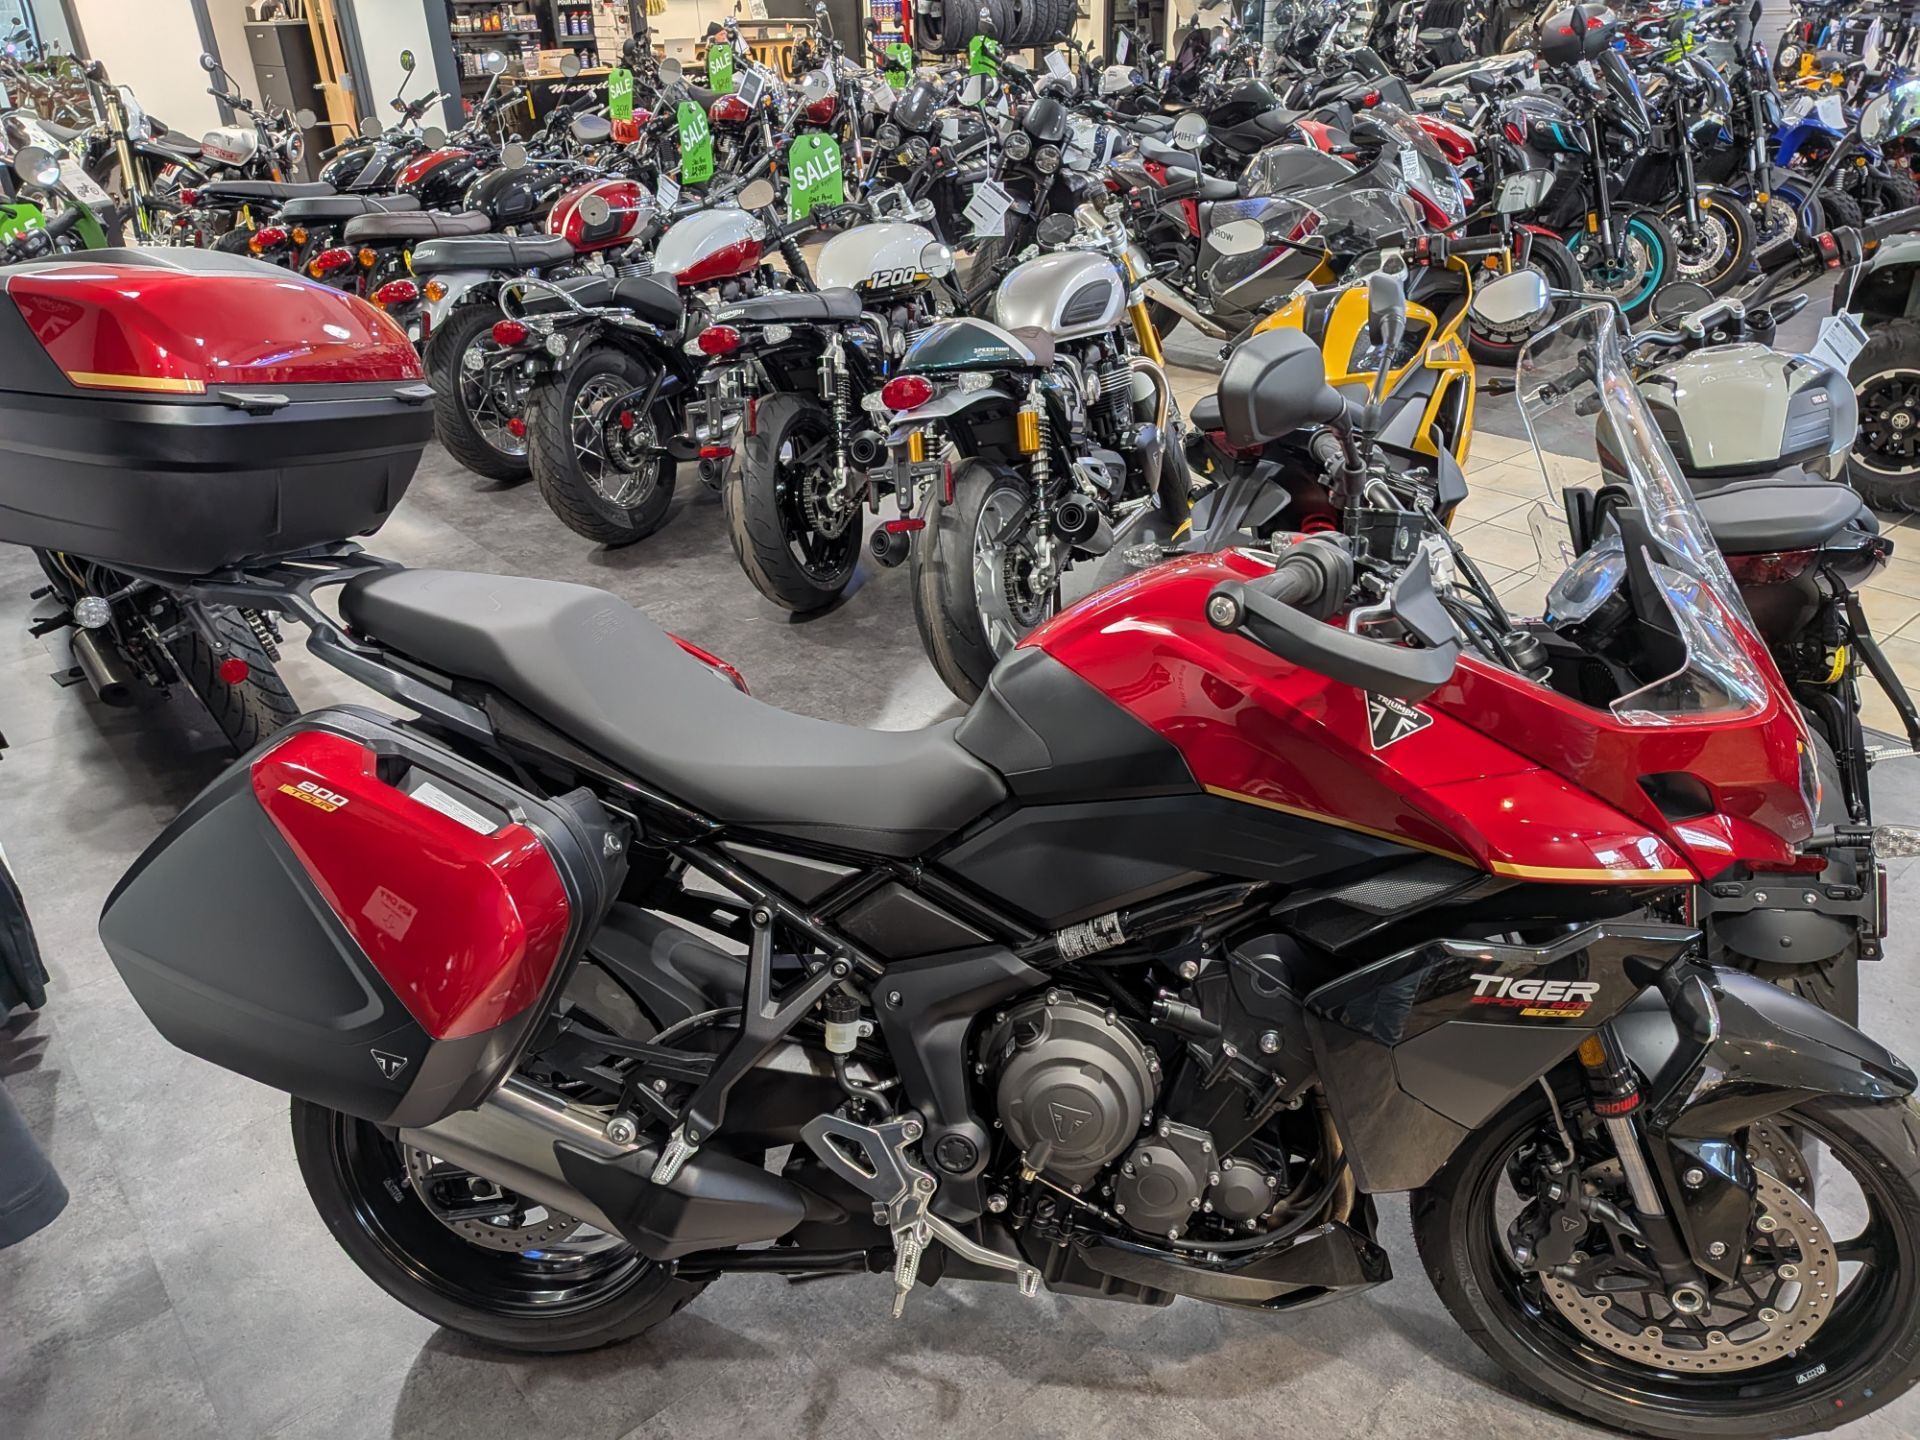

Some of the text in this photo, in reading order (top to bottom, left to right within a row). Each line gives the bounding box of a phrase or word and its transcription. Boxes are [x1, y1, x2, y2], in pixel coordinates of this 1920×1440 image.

[710, 52, 731, 75] SALE
[609, 78, 631, 99] SALE
[682, 113, 708, 152] SALE
[793, 147, 840, 191] SALE
[870, 266, 917, 290] 1200
[1377, 693, 1419, 720] TRIUMPH
[292, 789, 336, 811] TOUR
[296, 780, 350, 808] 800
[1469, 973, 1601, 1003] TIGER
[1471, 996, 1592, 1010] SPORT 800
[1534, 1008, 1583, 1017] TOUR
